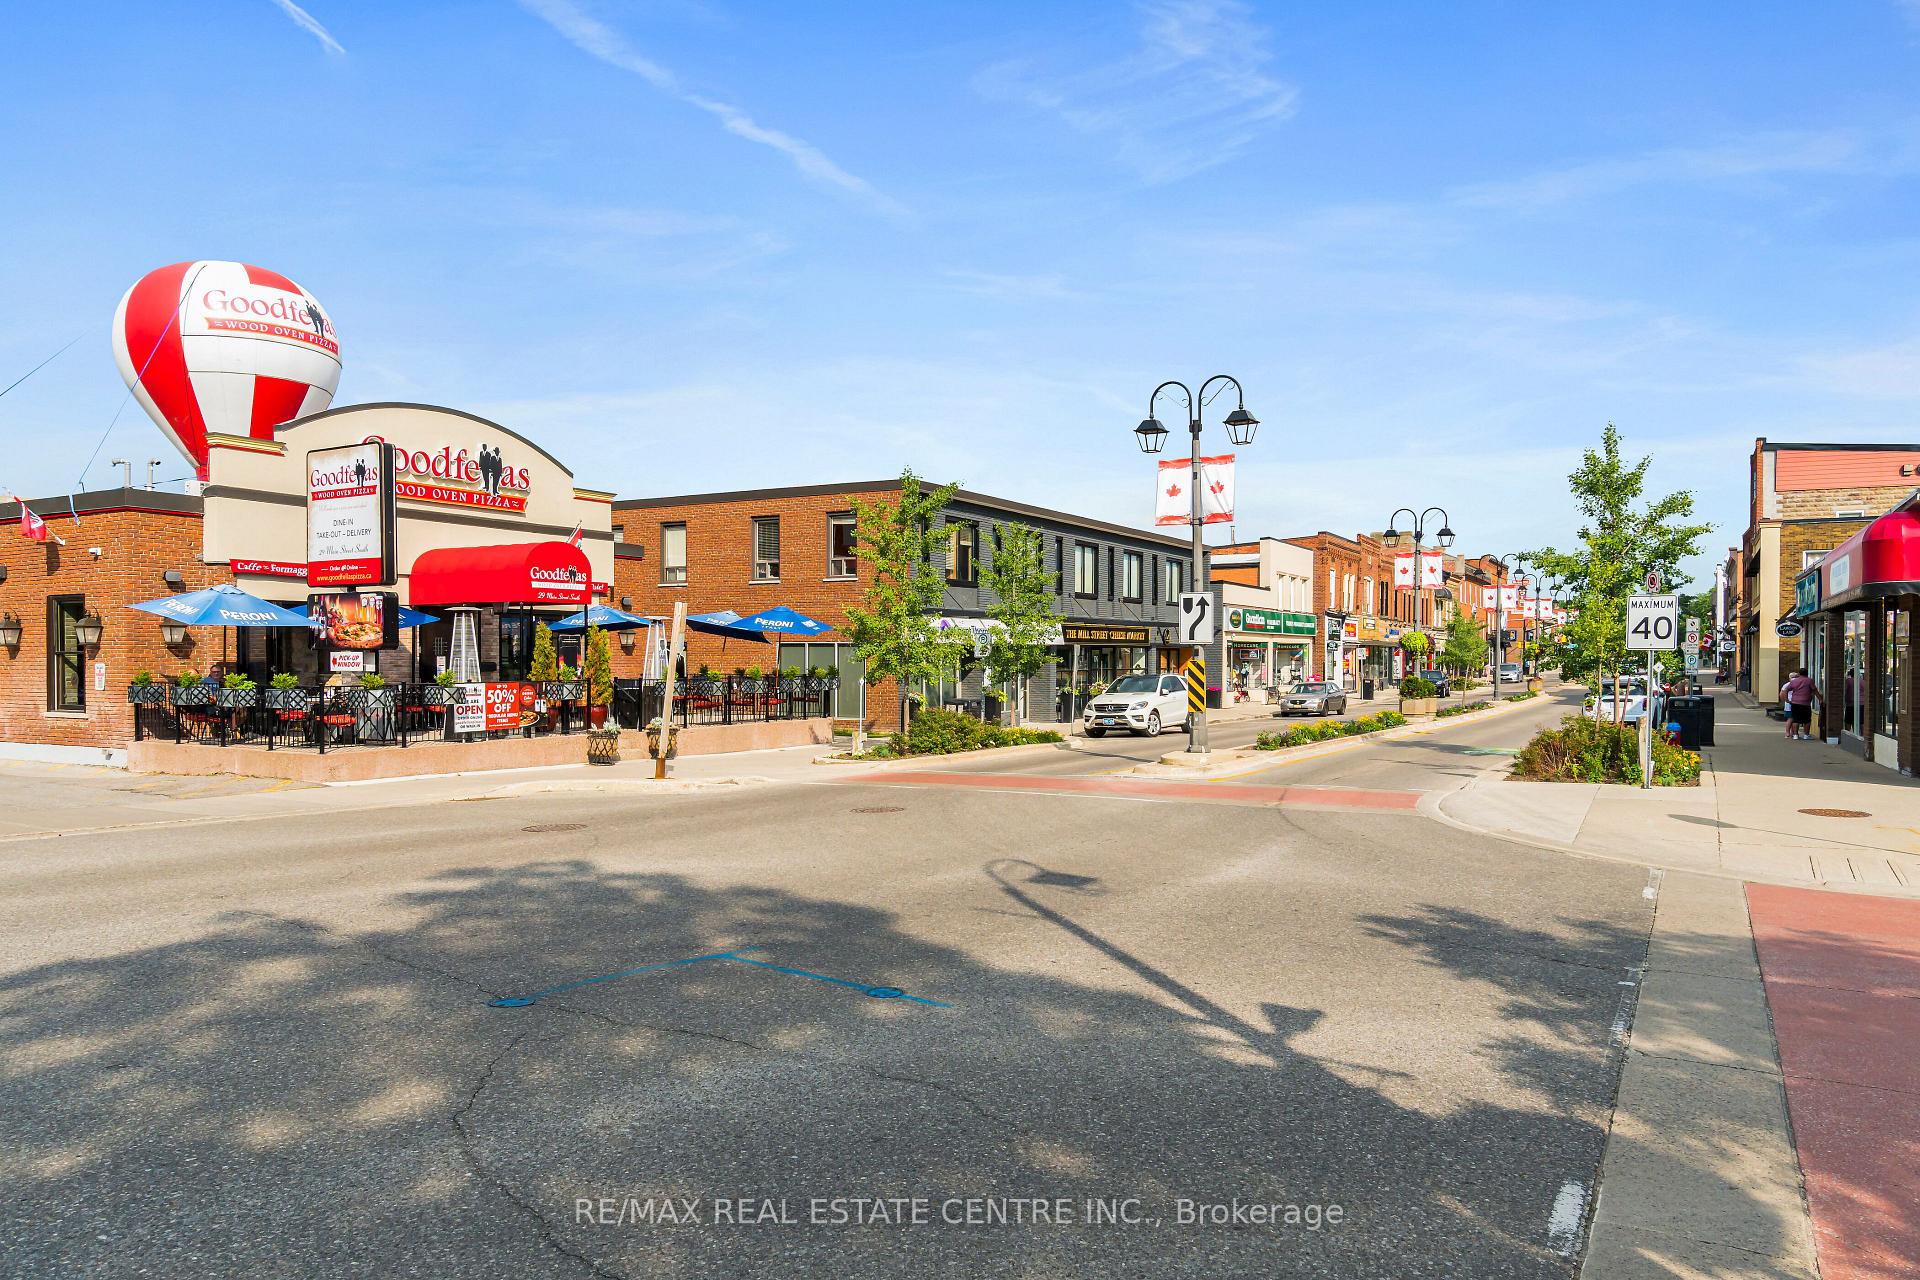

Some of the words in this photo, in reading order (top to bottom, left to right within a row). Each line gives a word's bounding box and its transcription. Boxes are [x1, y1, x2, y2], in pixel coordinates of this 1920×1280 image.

[203, 290, 337, 338] Goodfeas
[225, 321, 268, 332] WOOD
[275, 327, 305, 340] OVEN
[309, 335, 333, 350] PIZZA
[363, 436, 531, 489] oodfeas
[310, 465, 378, 488] Goodfeas
[317, 491, 335, 499] WOOD
[336, 489, 351, 497] OVEN
[396, 484, 426, 497] OOD
[432, 489, 467, 503] OVEN
[473, 494, 510, 508] PIZZA
[346, 528, 372, 537] DELIVERY
[237, 562, 262, 571] Caffe
[270, 564, 308, 577] Formagg
[530, 566, 587, 582] Goodfeas
[1630, 600, 1674, 609] MAXIMUM
[219, 609, 278, 621] PERONI
[754, 617, 794, 628] PERONI
[1631, 616, 1673, 640] 40
[1066, 629, 1077, 638] THE
[1077, 629, 1090, 639] MILL
[1091, 630, 1108, 640] STREET
[456, 704, 484, 716] OPEN
[493, 703, 512, 713] OFF
